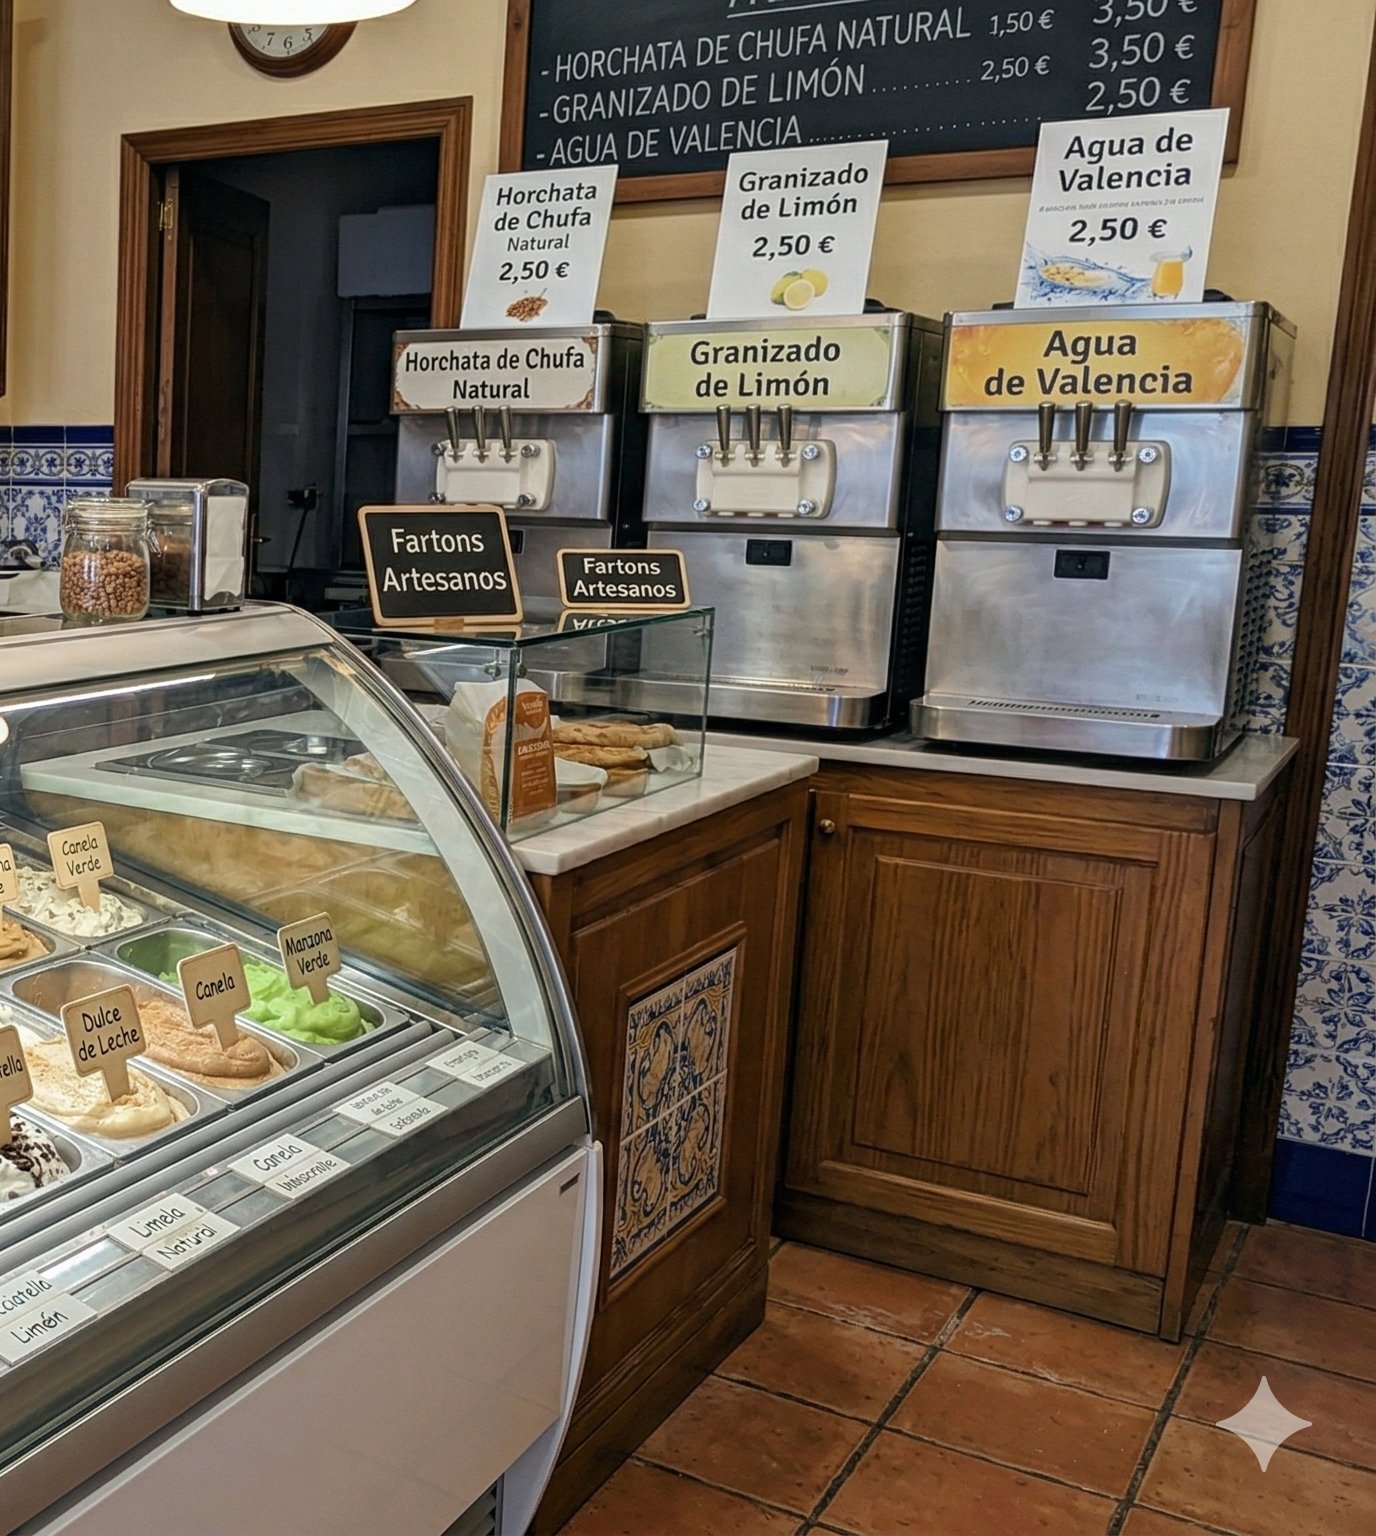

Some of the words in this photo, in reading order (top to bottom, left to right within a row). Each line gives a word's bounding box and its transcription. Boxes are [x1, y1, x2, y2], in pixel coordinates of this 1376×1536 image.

[283, 36, 293, 49] 6
[555, 40, 687, 82] HORCHATA
[696, 34, 730, 66] DE
[738, 23, 827, 62] CHUFA
[837, 6, 972, 51] NATURAL
[989, 11, 1033, 38] 1,50
[1037, 9, 1055, 30] €
[1089, 31, 1165, 73] 3,50
[1174, 34, 1195, 61] €
[553, 80, 711, 124] GRANIZADO
[721, 75, 758, 108] DE
[769, 57, 865, 103] LIMÓN
[980, 55, 1029, 83] 2,50
[1034, 55, 1051, 76] €
[1085, 76, 1161, 115] 2,50
[1169, 79, 1192, 105] €
[550, 132, 618, 166] AGUA
[627, 128, 660, 160] DE
[669, 115, 802, 156] VALENCIA
[1063, 135, 1145, 165] Agua
[1155, 127, 1193, 153] de
[738, 163, 869, 192] Granizado
[1059, 163, 1192, 192] Valencia
[496, 182, 597, 206] Horchata
[740, 199, 770, 220] de
[778, 193, 858, 218] Limón
[494, 212, 520, 231] de
[526, 207, 592, 229] Chufa
[1068, 217, 1138, 247] 2,50
[1147, 218, 1167, 239] €
[507, 233, 570, 252] Natural
[752, 235, 810, 261] 2,50
[818, 236, 836, 254] €
[499, 260, 549, 284] 2,50
[555, 261, 571, 278] €
[405, 349, 491, 372] Horchata
[497, 348, 520, 369] de
[525, 346, 585, 369] Chufa
[690, 335, 841, 365] Granizado
[1043, 330, 1137, 364] Agua
[453, 377, 530, 400] Natural
[695, 372, 729, 398] de
[738, 370, 830, 397] Limón
[984, 368, 1025, 396] de
[1037, 365, 1193, 395] Valencia
[390, 528, 485, 554] Fartons
[382, 567, 507, 593] Artesanos
[584, 558, 661, 575] Fartons
[573, 580, 677, 598] Artesanos
[62, 833, 99, 856] Canela
[66, 854, 102, 877] Verde
[297, 950, 330, 975] Verde
[195, 971, 236, 1001] Canela
[81, 1006, 122, 1033] Dulce
[78, 1041, 97, 1062] de
[98, 1025, 141, 1056] Leche
[253, 1144, 303, 1171] Canela
[128, 1205, 186, 1238] Limela
[157, 1223, 218, 1260] Natural
[10, 1309, 69, 1344] Limón
